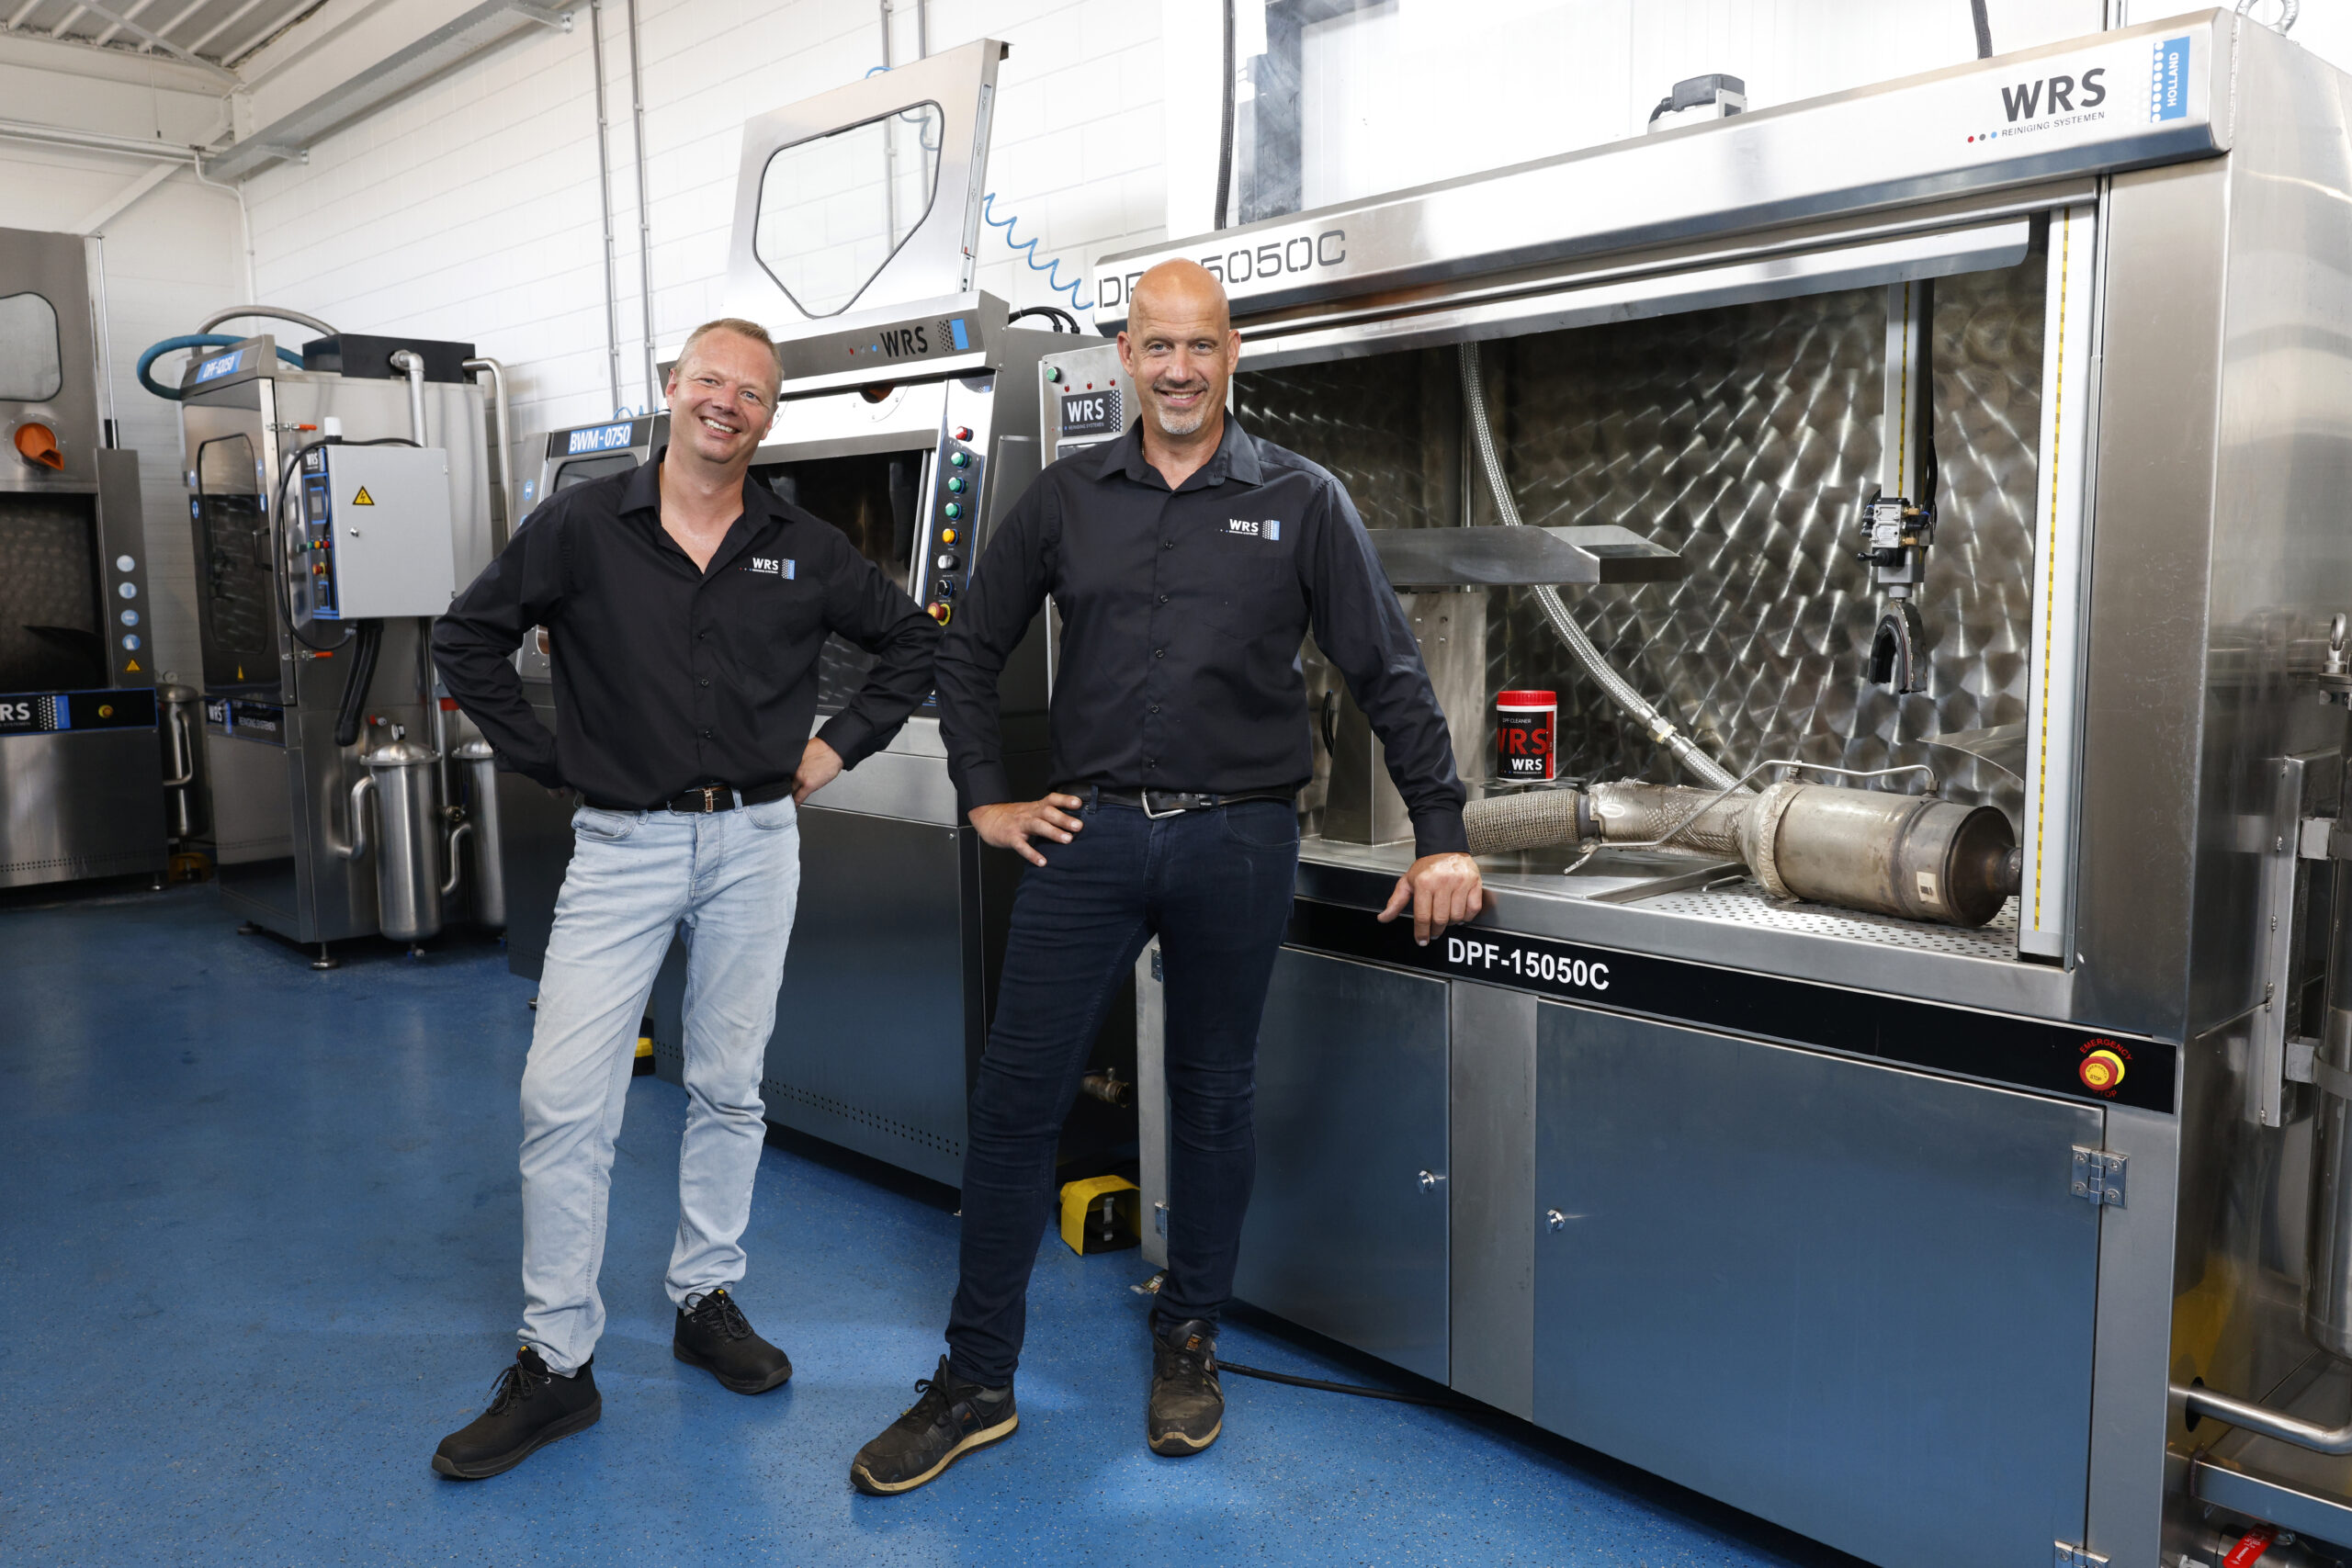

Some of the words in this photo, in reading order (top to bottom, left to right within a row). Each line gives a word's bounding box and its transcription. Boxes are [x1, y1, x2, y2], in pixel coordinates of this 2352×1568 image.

[2167, 52, 2179, 107] HOLLAND
[2001, 68, 2106, 122] WRS
[2002, 121, 2050, 137] REINIGING
[2053, 111, 2105, 128] SYSTEMEN
[880, 325, 928, 357] WRS
[1067, 398, 1104, 423] WRS
[1229, 518, 1259, 533] WRS
[752, 557, 779, 570] WRS
[0, 703, 30, 721] RS
[1511, 759, 1543, 771] WRS
[1448, 937, 1610, 990] DPF-15050C
[2080, 1038, 2132, 1059] EMERGENCY
